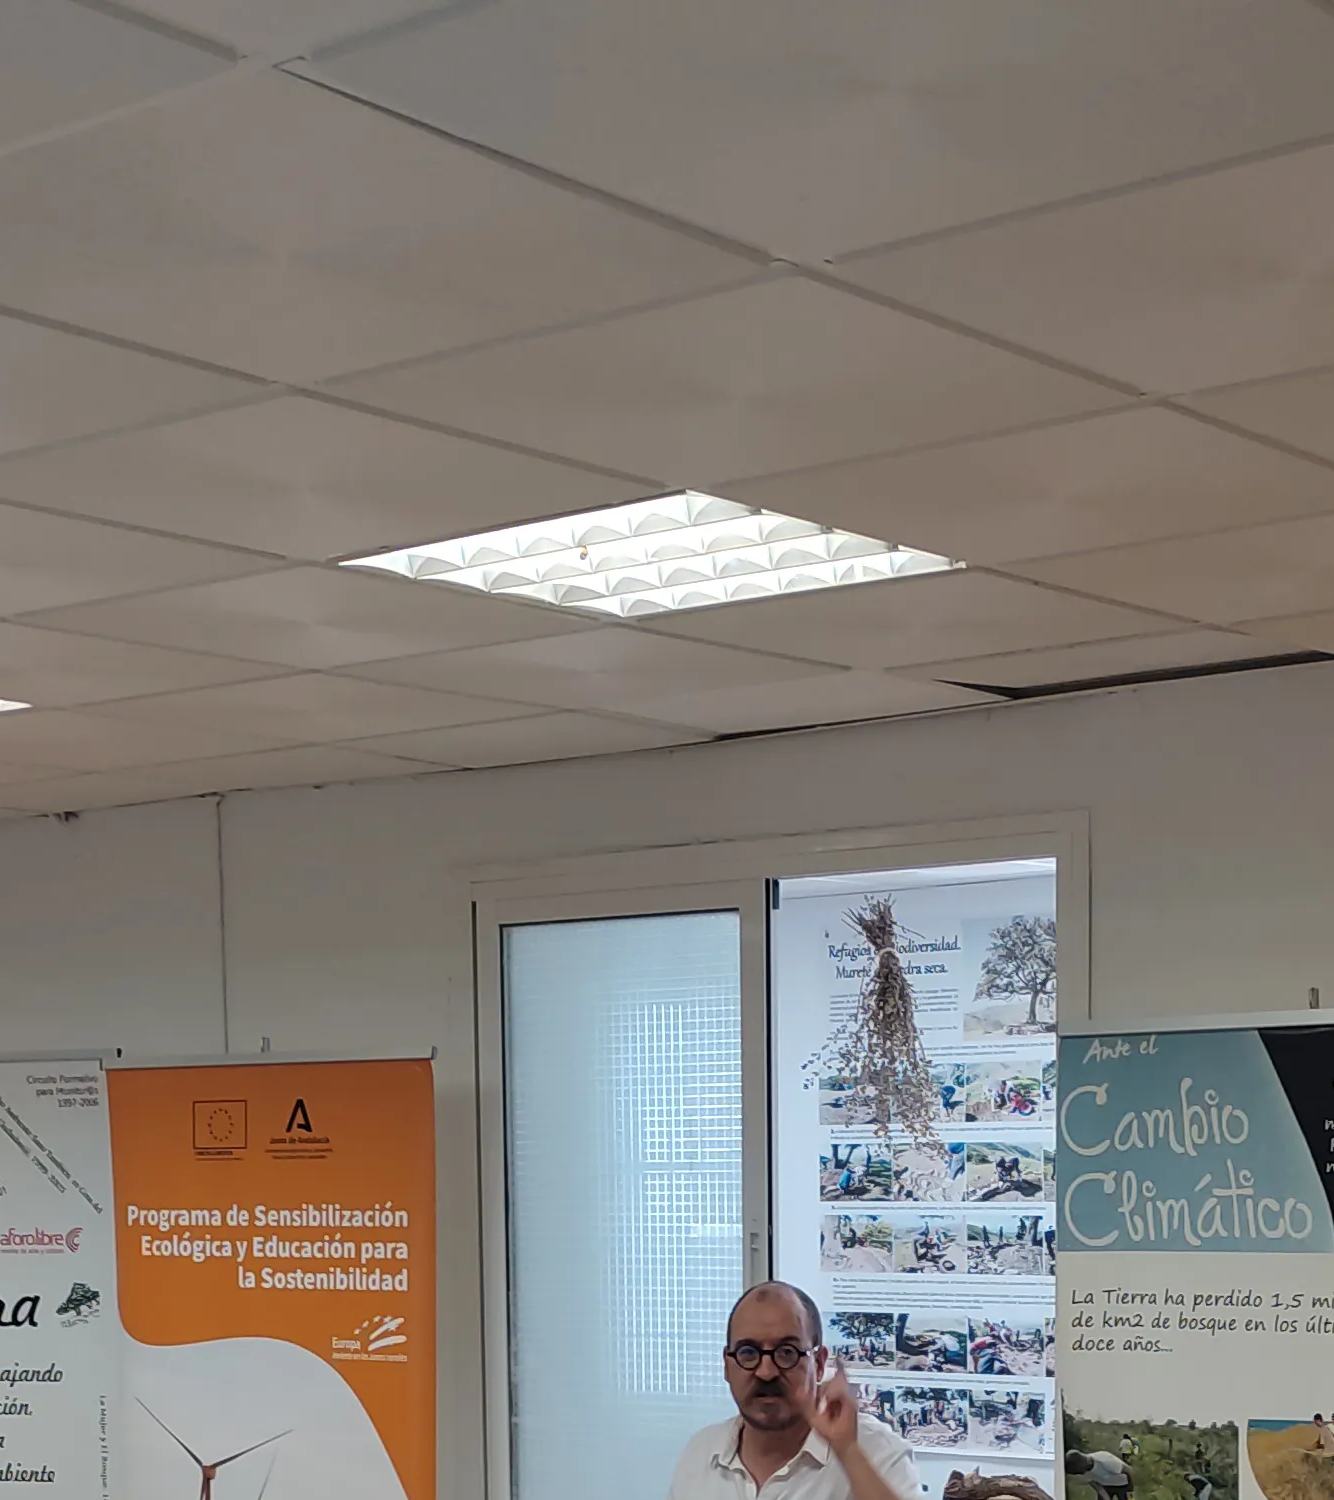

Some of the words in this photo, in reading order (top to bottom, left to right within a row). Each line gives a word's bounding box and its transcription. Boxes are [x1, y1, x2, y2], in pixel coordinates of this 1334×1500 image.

[1082, 1038, 1131, 1064] Ante
[1139, 1034, 1159, 1055] el
[1061, 1077, 1249, 1156] Cambio
[127, 1205, 221, 1231] Programa
[226, 1205, 249, 1227] de
[254, 1201, 409, 1228] Sensibilización
[1065, 1159, 1313, 1247] Climático
[141, 1232, 232, 1262] Ecológica
[236, 1240, 248, 1262] y
[252, 1233, 355, 1259] Educación
[361, 1242, 409, 1263] para
[238, 1266, 255, 1288] la
[261, 1267, 409, 1291] Sostenibilidad
[1071, 1290, 1094, 1305] La
[1102, 1288, 1157, 1305] Tierra
[1166, 1289, 1185, 1306] ha
[1193, 1290, 1262, 1313] perdido
[1271, 1293, 1304, 1310] 1,5
[1072, 1311, 1094, 1328] de
[1102, 1313, 1145, 1329] km2
[1152, 1312, 1170, 1329] de
[1178, 1314, 1236, 1336] bosque
[1245, 1319, 1266, 1331] en
[1275, 1315, 1298, 1333] los
[1072, 1335, 1115, 1351] doce
